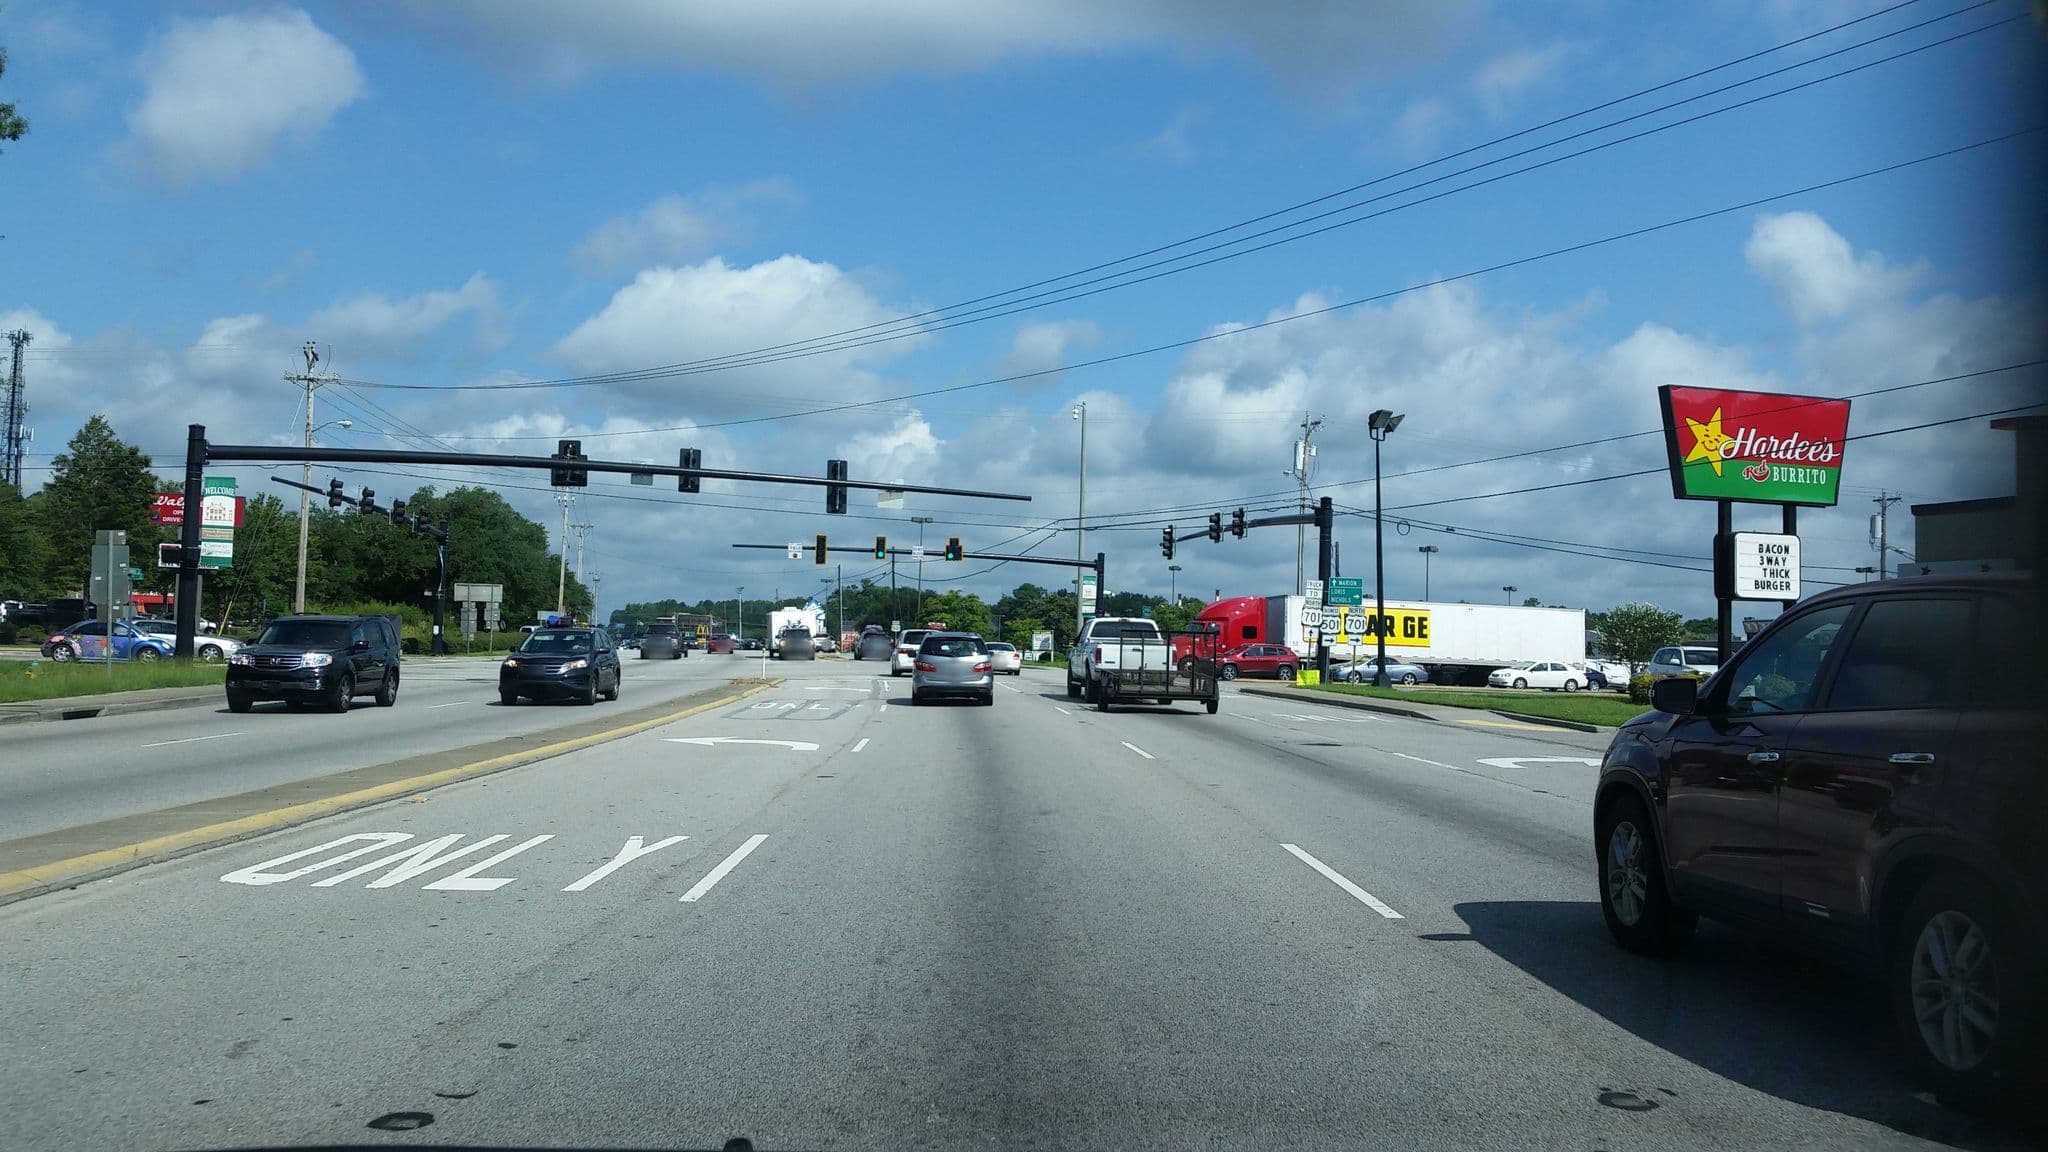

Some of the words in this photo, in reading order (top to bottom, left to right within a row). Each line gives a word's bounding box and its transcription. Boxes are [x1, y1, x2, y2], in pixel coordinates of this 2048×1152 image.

[1719, 427, 1840, 461] Hardee's
[1742, 460, 1771, 483] Red
[1772, 466, 1827, 485] BURRITO
[204, 486, 235, 496] WELCOME
[1758, 543, 1790, 555] BACON
[1762, 567, 1791, 579] THICK
[1754, 579, 1792, 591] BURGER
[1305, 612, 1321, 623] 701
[1347, 619, 1365, 628] 701
[1322, 619, 1339, 630] 501
[219, 830, 691, 892] ONLY
